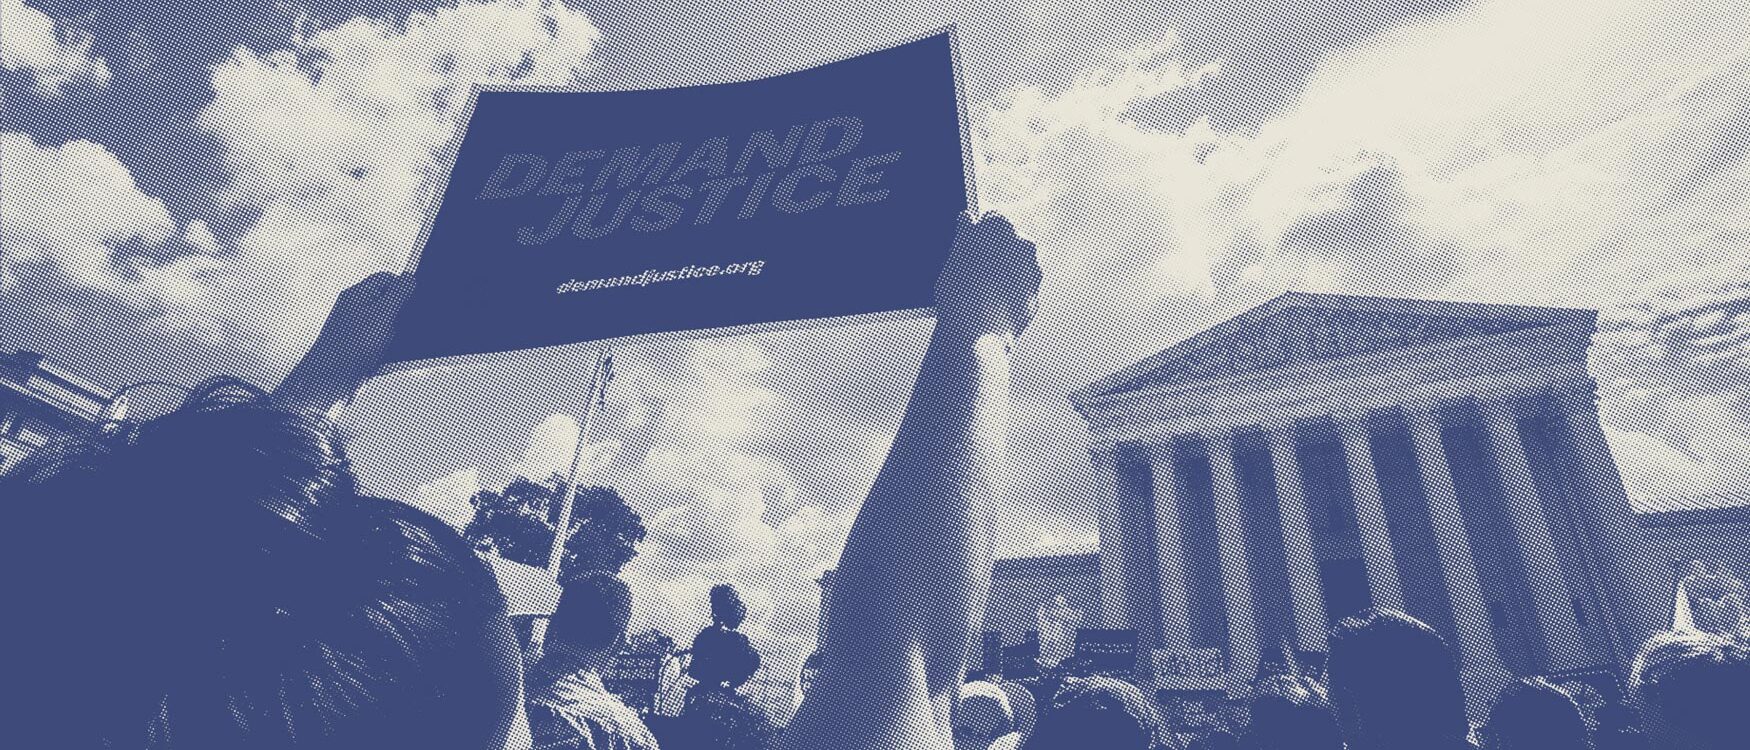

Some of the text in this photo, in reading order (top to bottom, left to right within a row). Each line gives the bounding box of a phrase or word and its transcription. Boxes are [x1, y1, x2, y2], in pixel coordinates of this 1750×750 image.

[475, 115, 864, 201] DEMAND
[516, 151, 902, 246] JUSTICE
[556, 260, 766, 294] demandjustice.org
